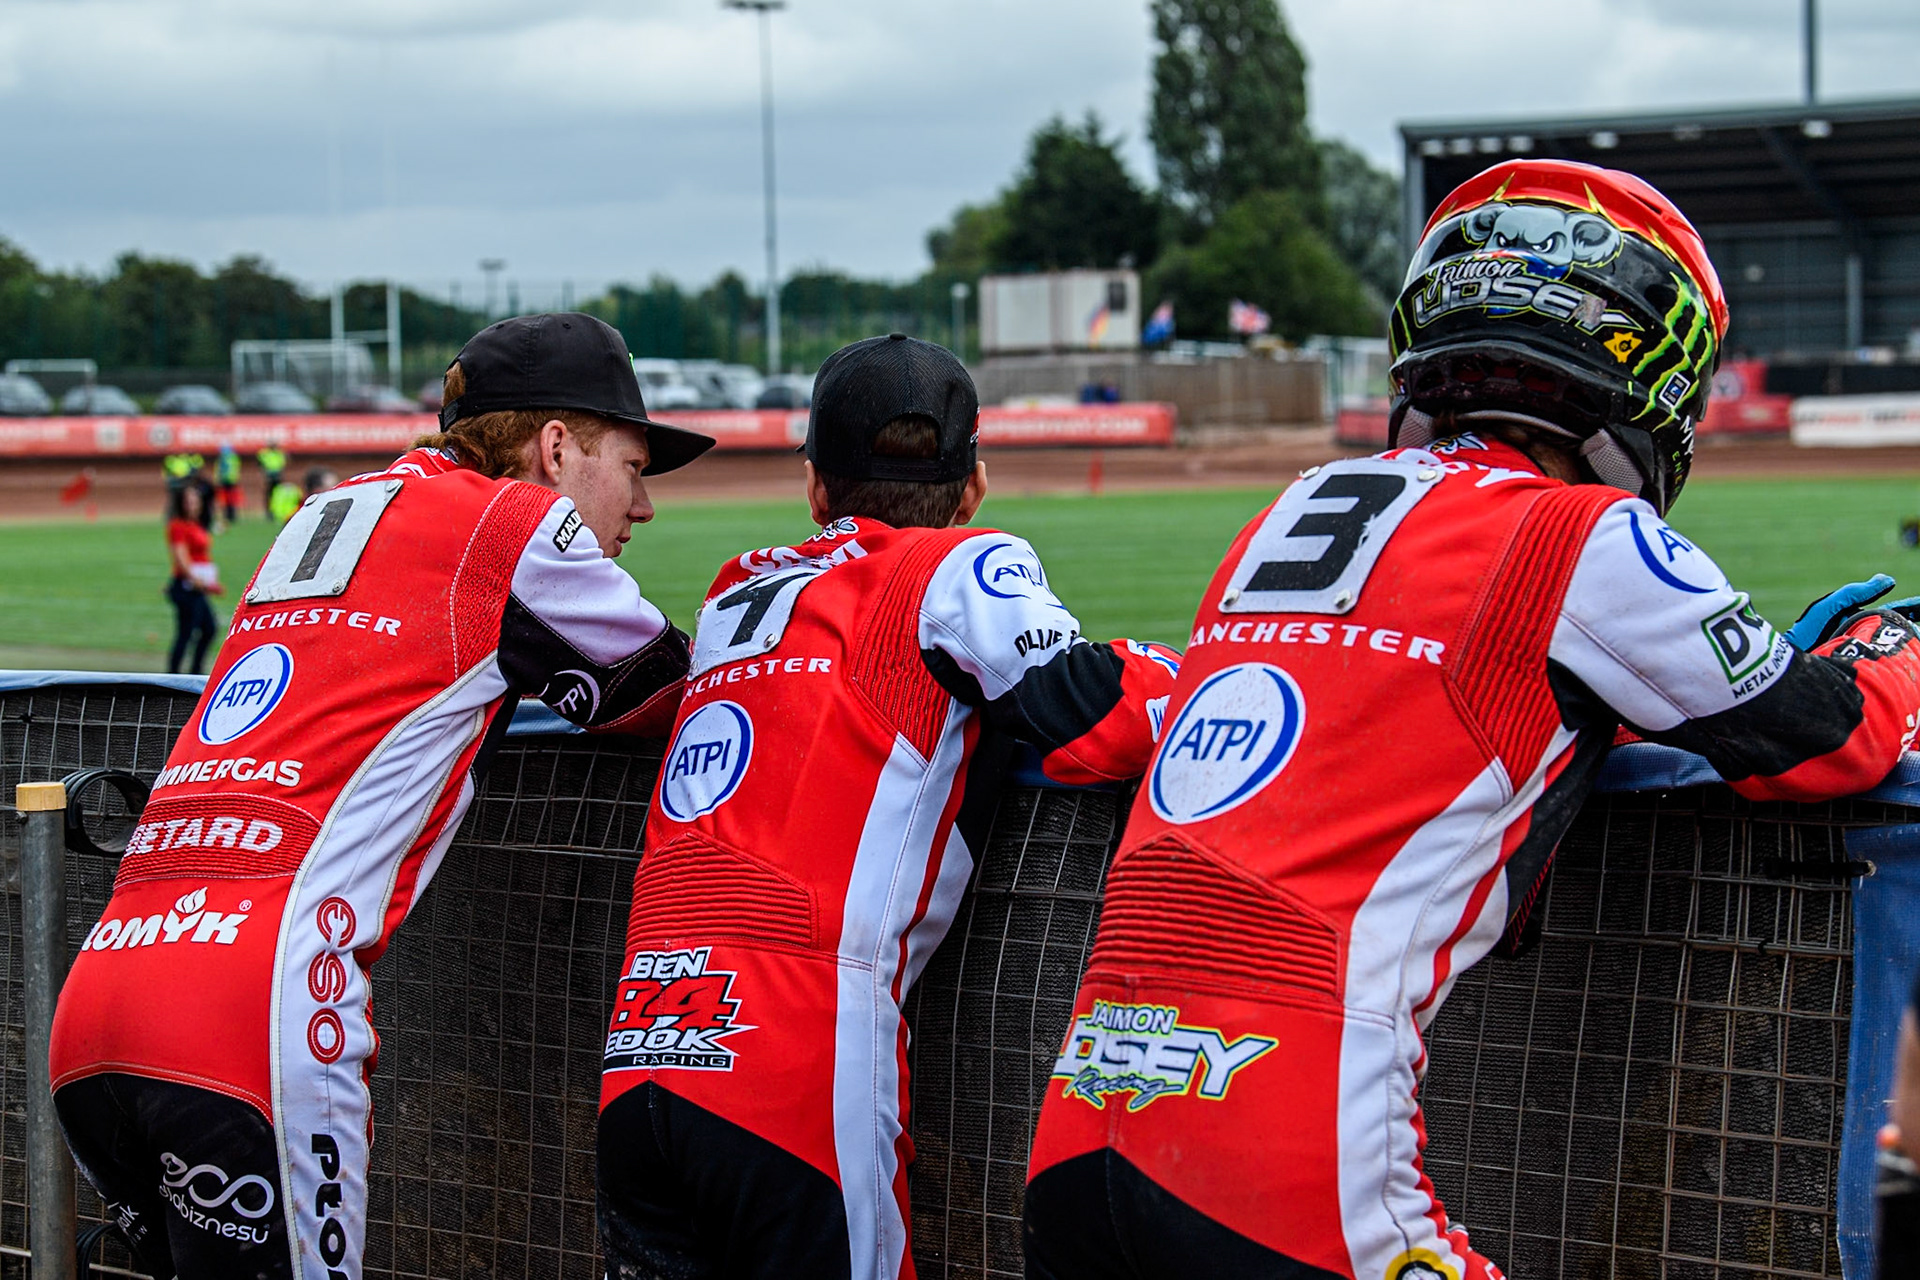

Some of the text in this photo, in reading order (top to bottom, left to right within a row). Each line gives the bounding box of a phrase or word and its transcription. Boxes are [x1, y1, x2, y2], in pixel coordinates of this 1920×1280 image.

[290, 498, 354, 583] 1
[1244, 474, 1406, 592] 3
[215, 678, 273, 710] ATPI
[1731, 666, 1775, 700] METAL
[1170, 718, 1267, 761] ATPI
[670, 738, 732, 782] ATPI
[123, 817, 284, 858] BETARD
[629, 951, 706, 980] BEN
[1087, 1002, 1175, 1033] JAIMON
[633, 1054, 727, 1067] RACING
